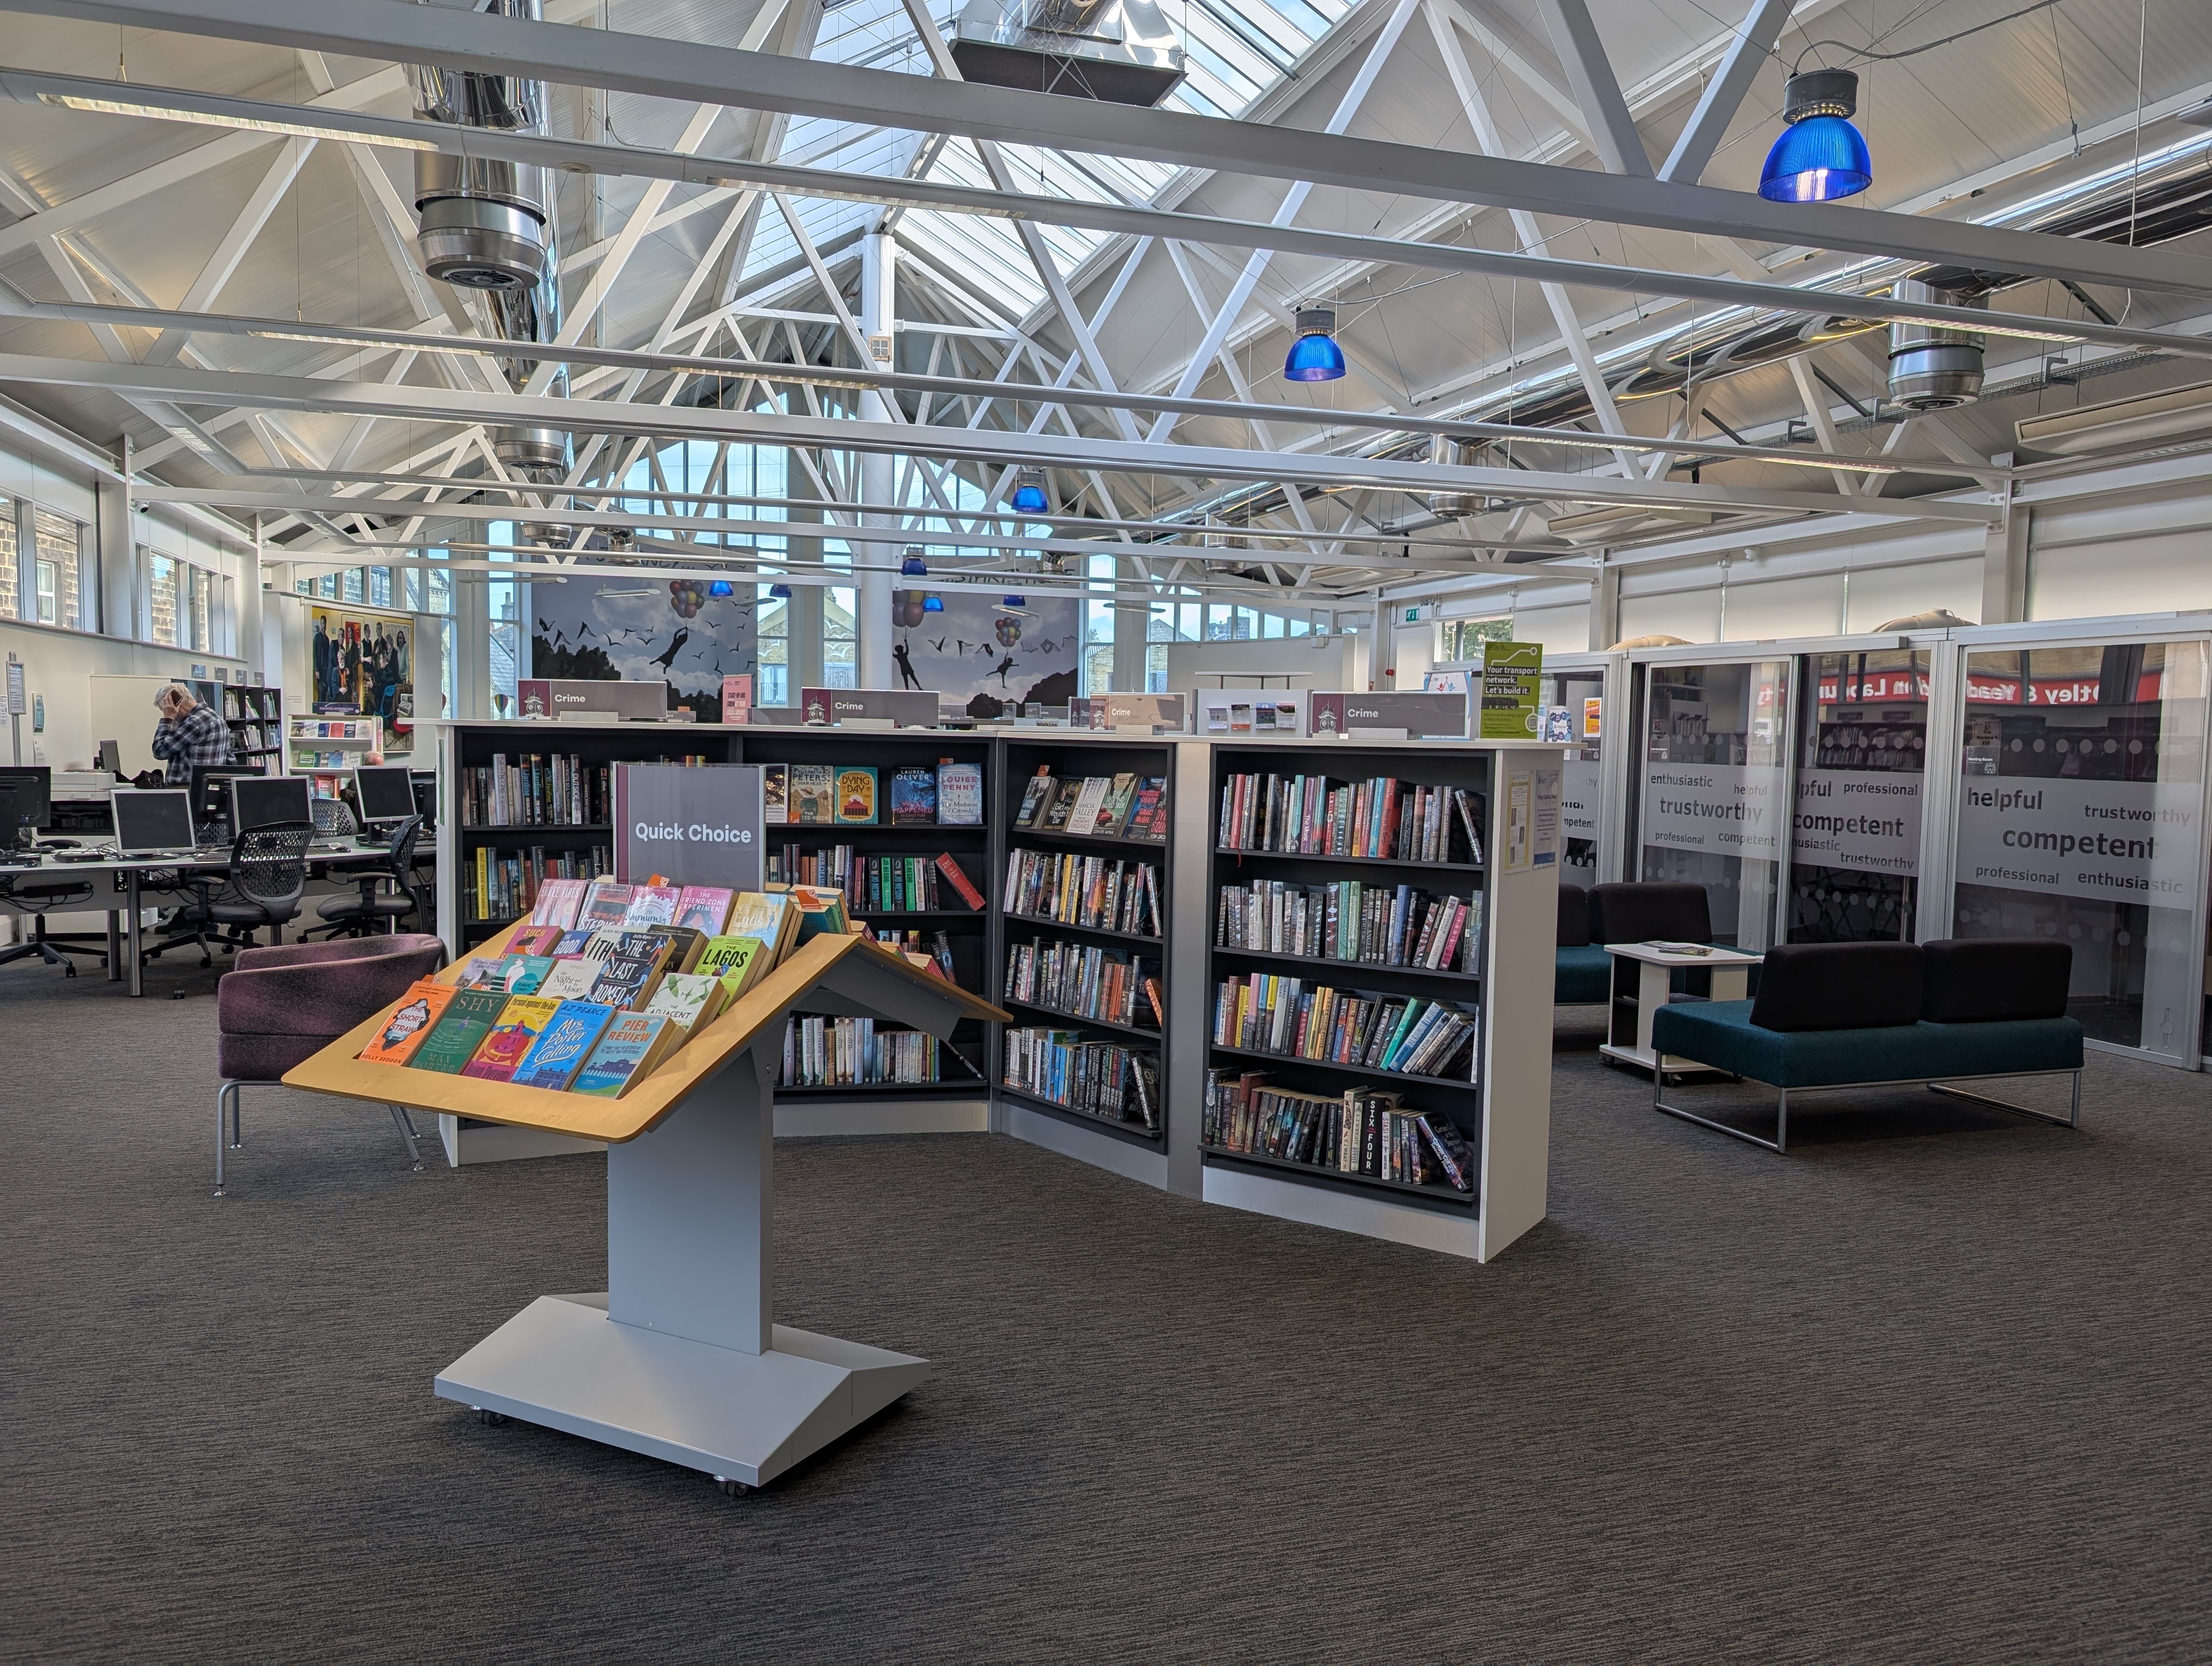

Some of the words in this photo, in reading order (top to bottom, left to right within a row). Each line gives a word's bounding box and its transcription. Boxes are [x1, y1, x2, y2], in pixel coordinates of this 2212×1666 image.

[1504, 667, 1538, 676] transport
[554, 694, 586, 703] Crime
[834, 701, 864, 711] Crime
[1111, 708, 1131, 716] Crime
[1347, 708, 1379, 718] Crime
[842, 776, 870, 785] DYING
[1650, 773, 1713, 788] enthusiastic
[847, 785, 865, 793] DAY
[1734, 784, 1767, 797] helpful
[1796, 779, 1832, 799] lpful
[1843, 781, 1918, 796] professional
[1967, 786, 2042, 812] helpful
[1075, 808, 1096, 816] TALLEY
[1660, 797, 1763, 826] trustworthy
[2084, 804, 2191, 827] trustworthy
[1564, 817, 1595, 829] mpetent
[1792, 813, 1904, 837] competent
[635, 822, 684, 842] Quick
[689, 824, 751, 843] Choice
[1655, 831, 1704, 845] professional
[1718, 832, 1776, 847] competent
[1792, 837, 1841, 852] husiastic
[2002, 829, 2159, 860] competent
[1840, 851, 1914, 870] trustworthy
[1976, 866, 2059, 885] professional
[2078, 872, 2182, 894] enthusiastic
[541, 886, 561, 897] THREE
[562, 888, 580, 899] FIRES
[678, 904, 725, 913] EXPERIMENT
[739, 903, 751, 912] The
[628, 912, 666, 924] Unmumsy
[734, 911, 763, 926] Ends
[523, 928, 546, 937] SUCH
[625, 939, 647, 957] THE
[702, 949, 748, 968] LAGOS
[609, 961, 639, 980] LAST
[554, 974, 575, 986] Night
[562, 984, 583, 994] Moon
[592, 984, 627, 1004] ROMEO
[456, 997, 500, 1013] SHY
[561, 1004, 576, 1013] AJ
[577, 1005, 608, 1016] PEARCE
[398, 1013, 423, 1023] SHORT
[650, 1009, 692, 1020] ADJACENT
[390, 1023, 418, 1034] STRAW
[556, 1018, 586, 1034] Mrs
[622, 1019, 650, 1031] PIER
[547, 1031, 588, 1045] Porter
[607, 1031, 652, 1043] REVIEW
[361, 1054, 378, 1062] HOLLY
[380, 1056, 402, 1065] SEDDON
[428, 1053, 451, 1063] MAX
[533, 1043, 583, 1068] Calling
[413, 1060, 456, 1073] PORTER
[466, 1063, 486, 1077] Helen
[1441, 1161, 1450, 1174] Hotel
